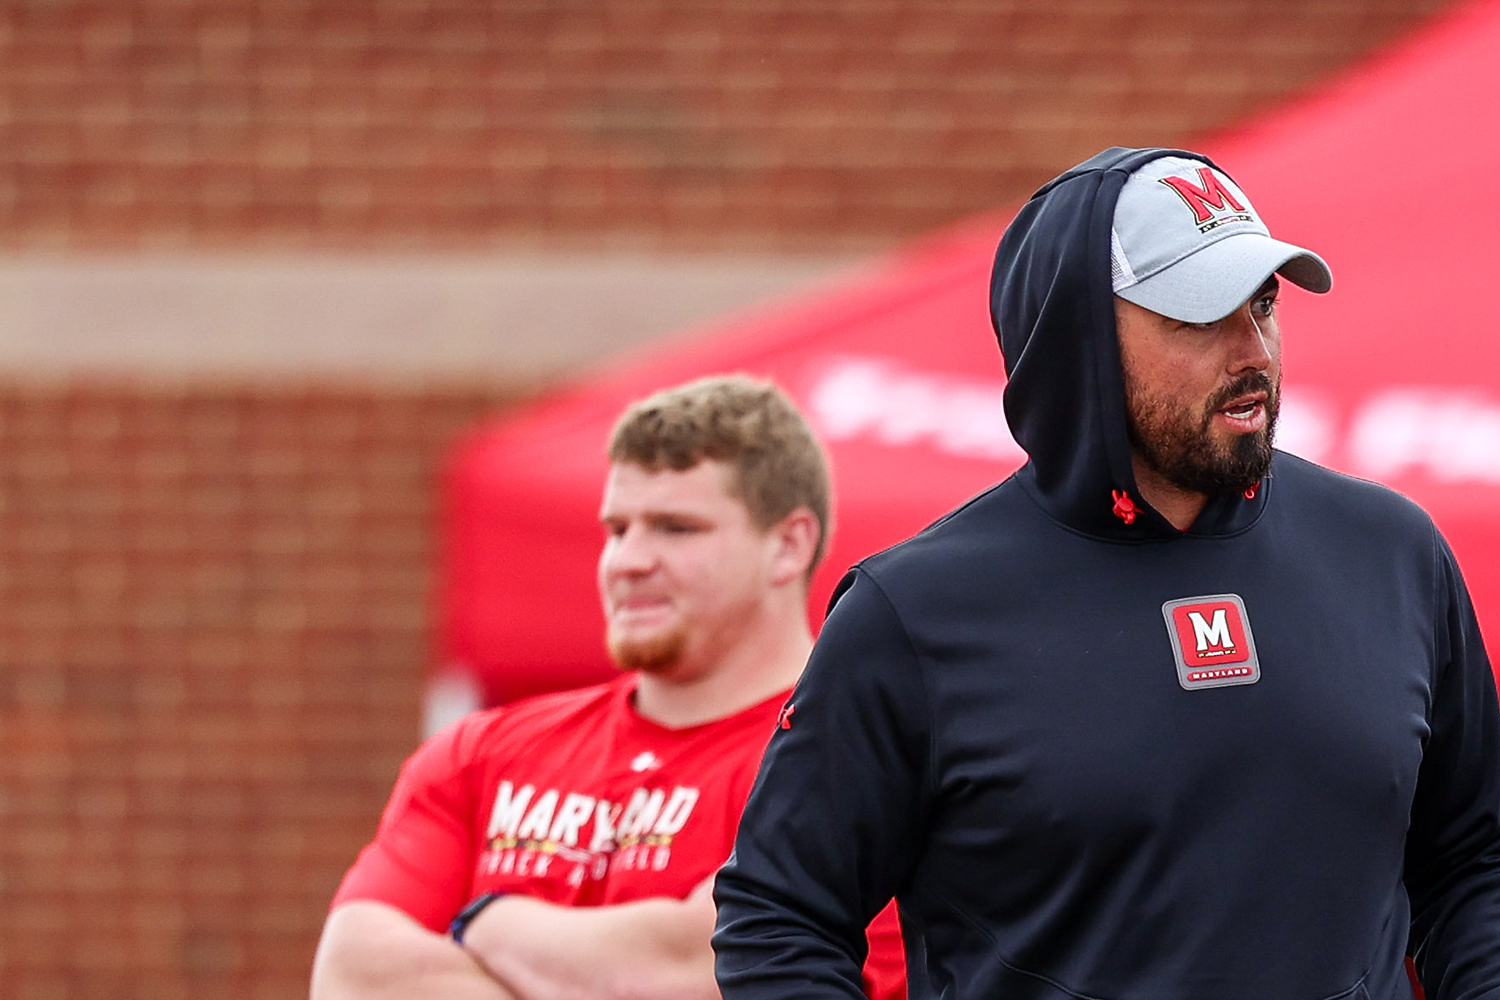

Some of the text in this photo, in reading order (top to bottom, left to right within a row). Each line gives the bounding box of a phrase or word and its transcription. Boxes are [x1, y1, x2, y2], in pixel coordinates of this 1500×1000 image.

[1158, 167, 1248, 225] M
[1188, 610, 1235, 651] M
[1193, 669, 1247, 679] MARYLAND
[486, 780, 700, 852] MARYAND
